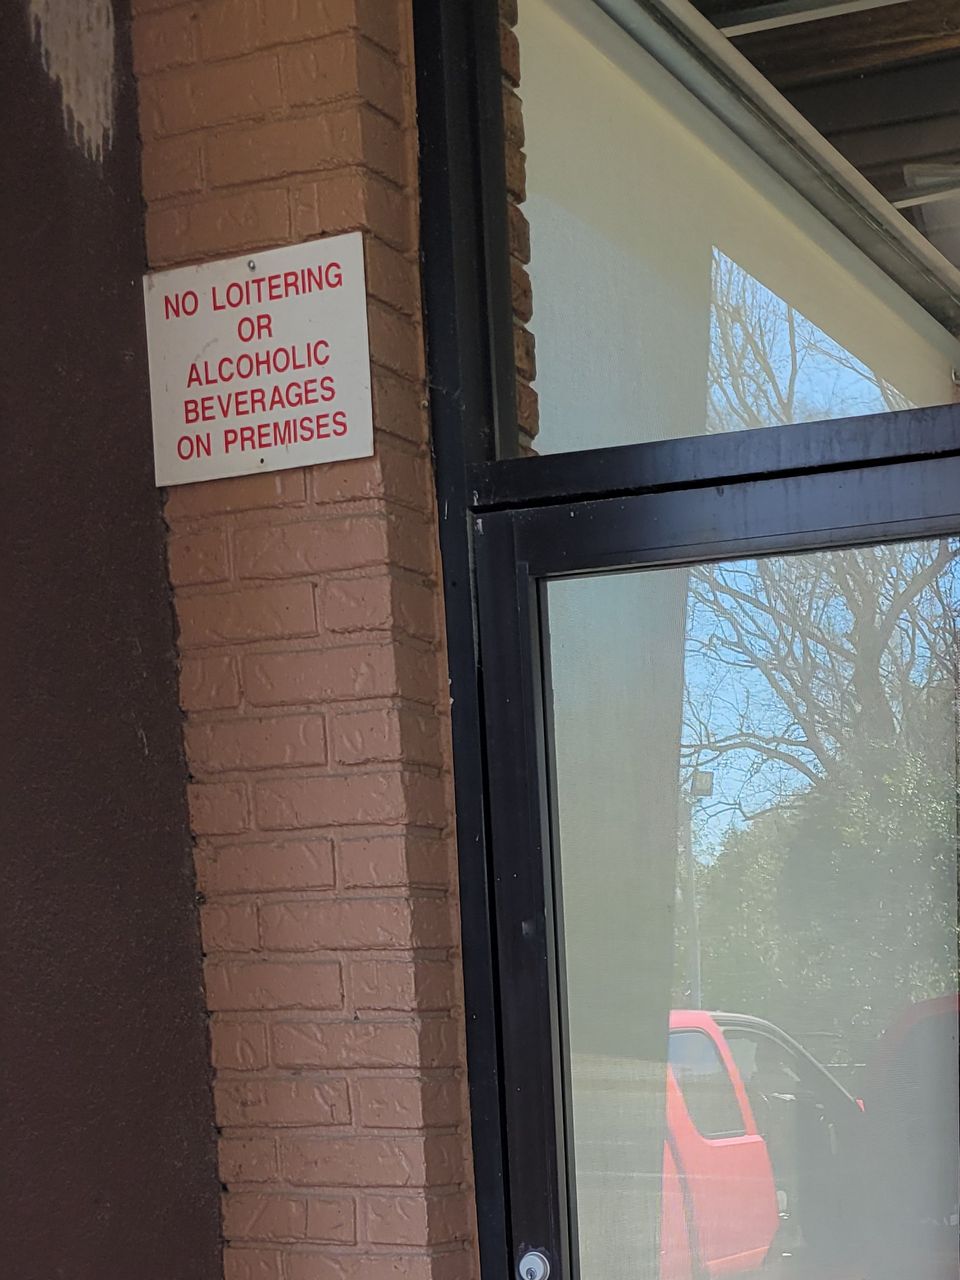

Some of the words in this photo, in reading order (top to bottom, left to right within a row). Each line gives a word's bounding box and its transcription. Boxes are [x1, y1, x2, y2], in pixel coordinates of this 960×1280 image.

[163, 289, 200, 320] NO
[211, 261, 344, 312] LOITERING
[237, 313, 273, 343] OR
[186, 339, 330, 389] ALCOHOLIC
[183, 375, 337, 425] BEVERAGES
[176, 431, 212, 461] ON
[223, 410, 349, 454] PREMISES
